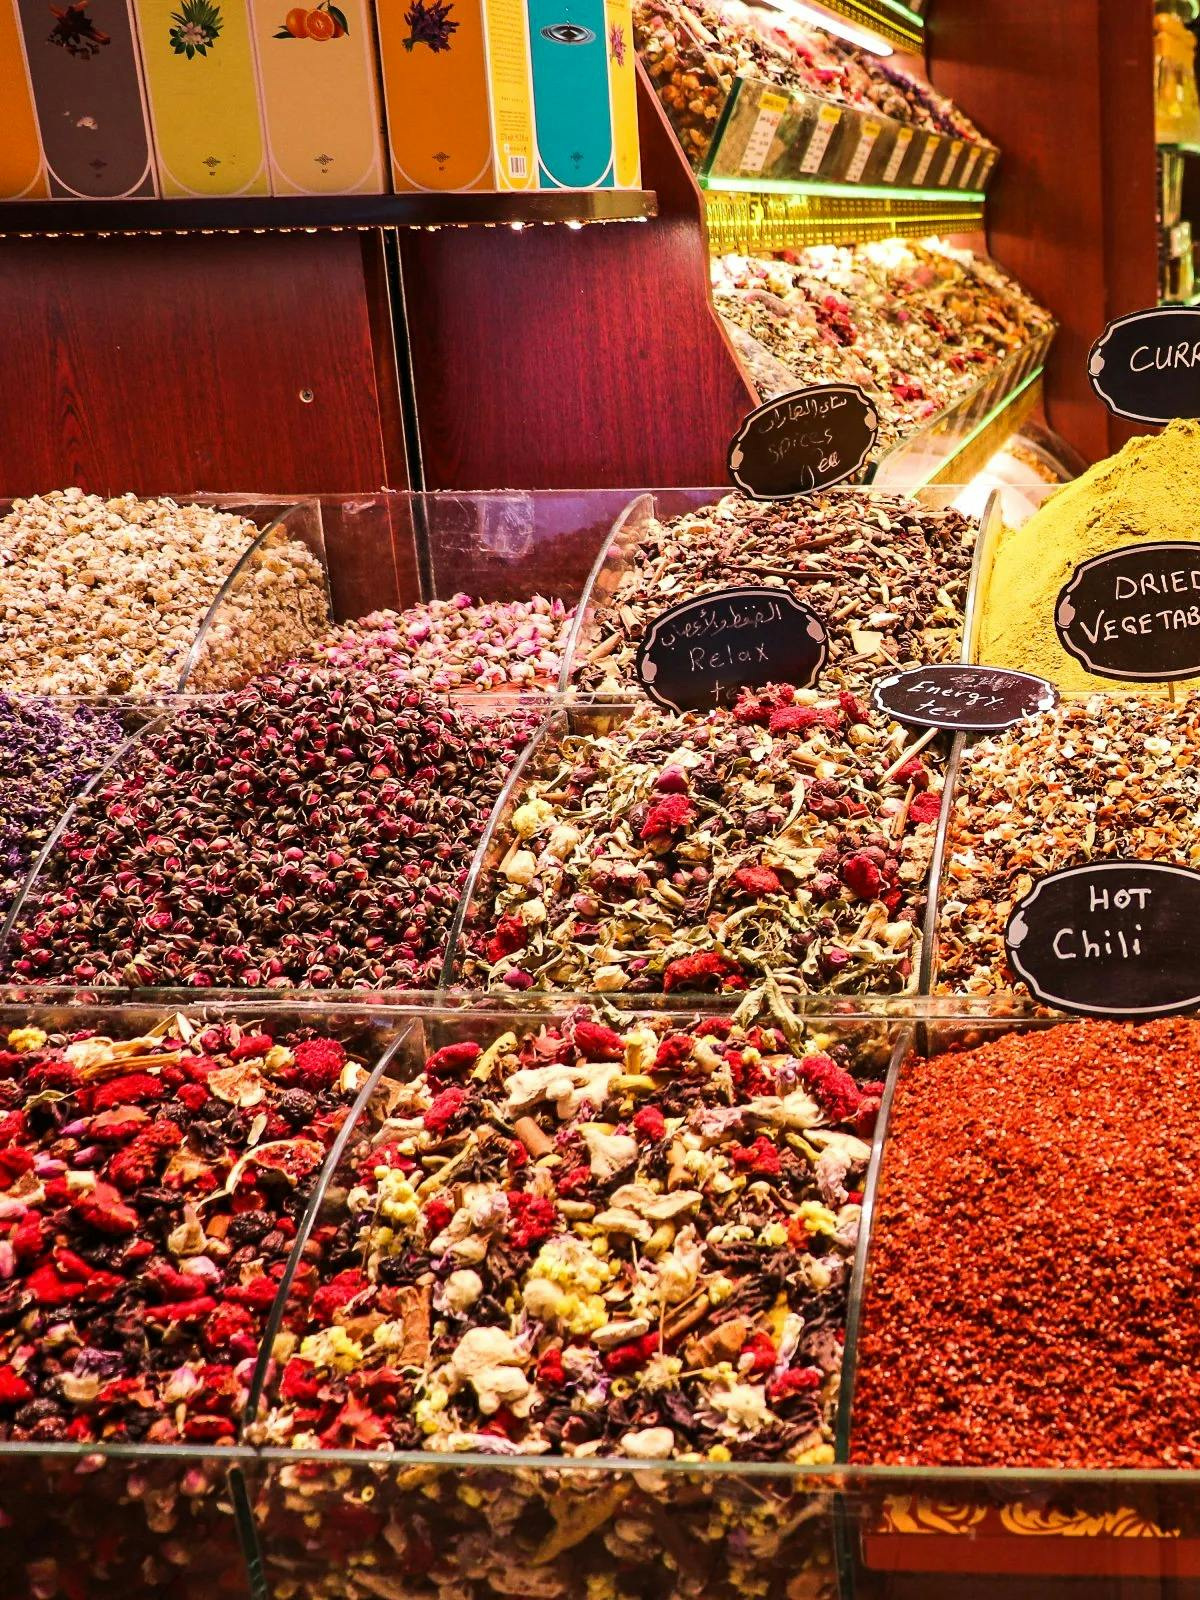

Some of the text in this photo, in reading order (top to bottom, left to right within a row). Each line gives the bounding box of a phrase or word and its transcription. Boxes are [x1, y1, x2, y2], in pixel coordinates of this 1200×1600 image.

[689, 643, 769, 671] Relax
[907, 680, 1005, 706] Energy
[915, 699, 963, 718] tea
[1090, 885, 1151, 912] HOT
[1053, 924, 1142, 960] Chili
